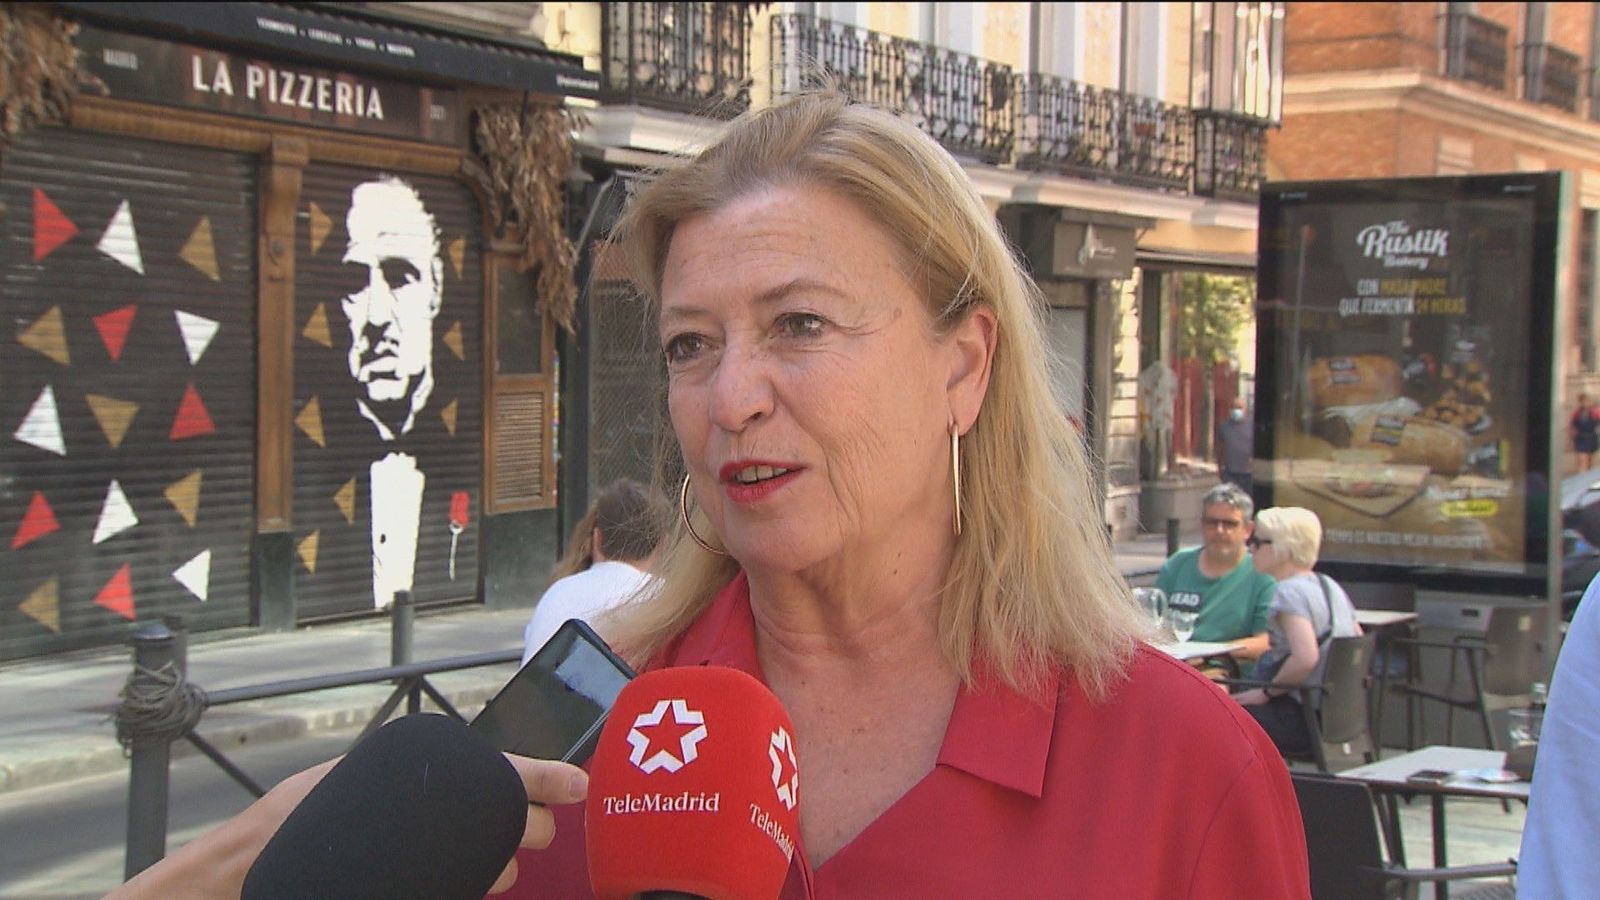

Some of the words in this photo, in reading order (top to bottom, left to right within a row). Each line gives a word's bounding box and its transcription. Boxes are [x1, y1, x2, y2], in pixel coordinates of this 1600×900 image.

[192, 55, 234, 96] LA
[246, 64, 384, 120] PIZZERIA
[1357, 225, 1449, 257] Rustik
[603, 791, 720, 815] TeleMadrid
